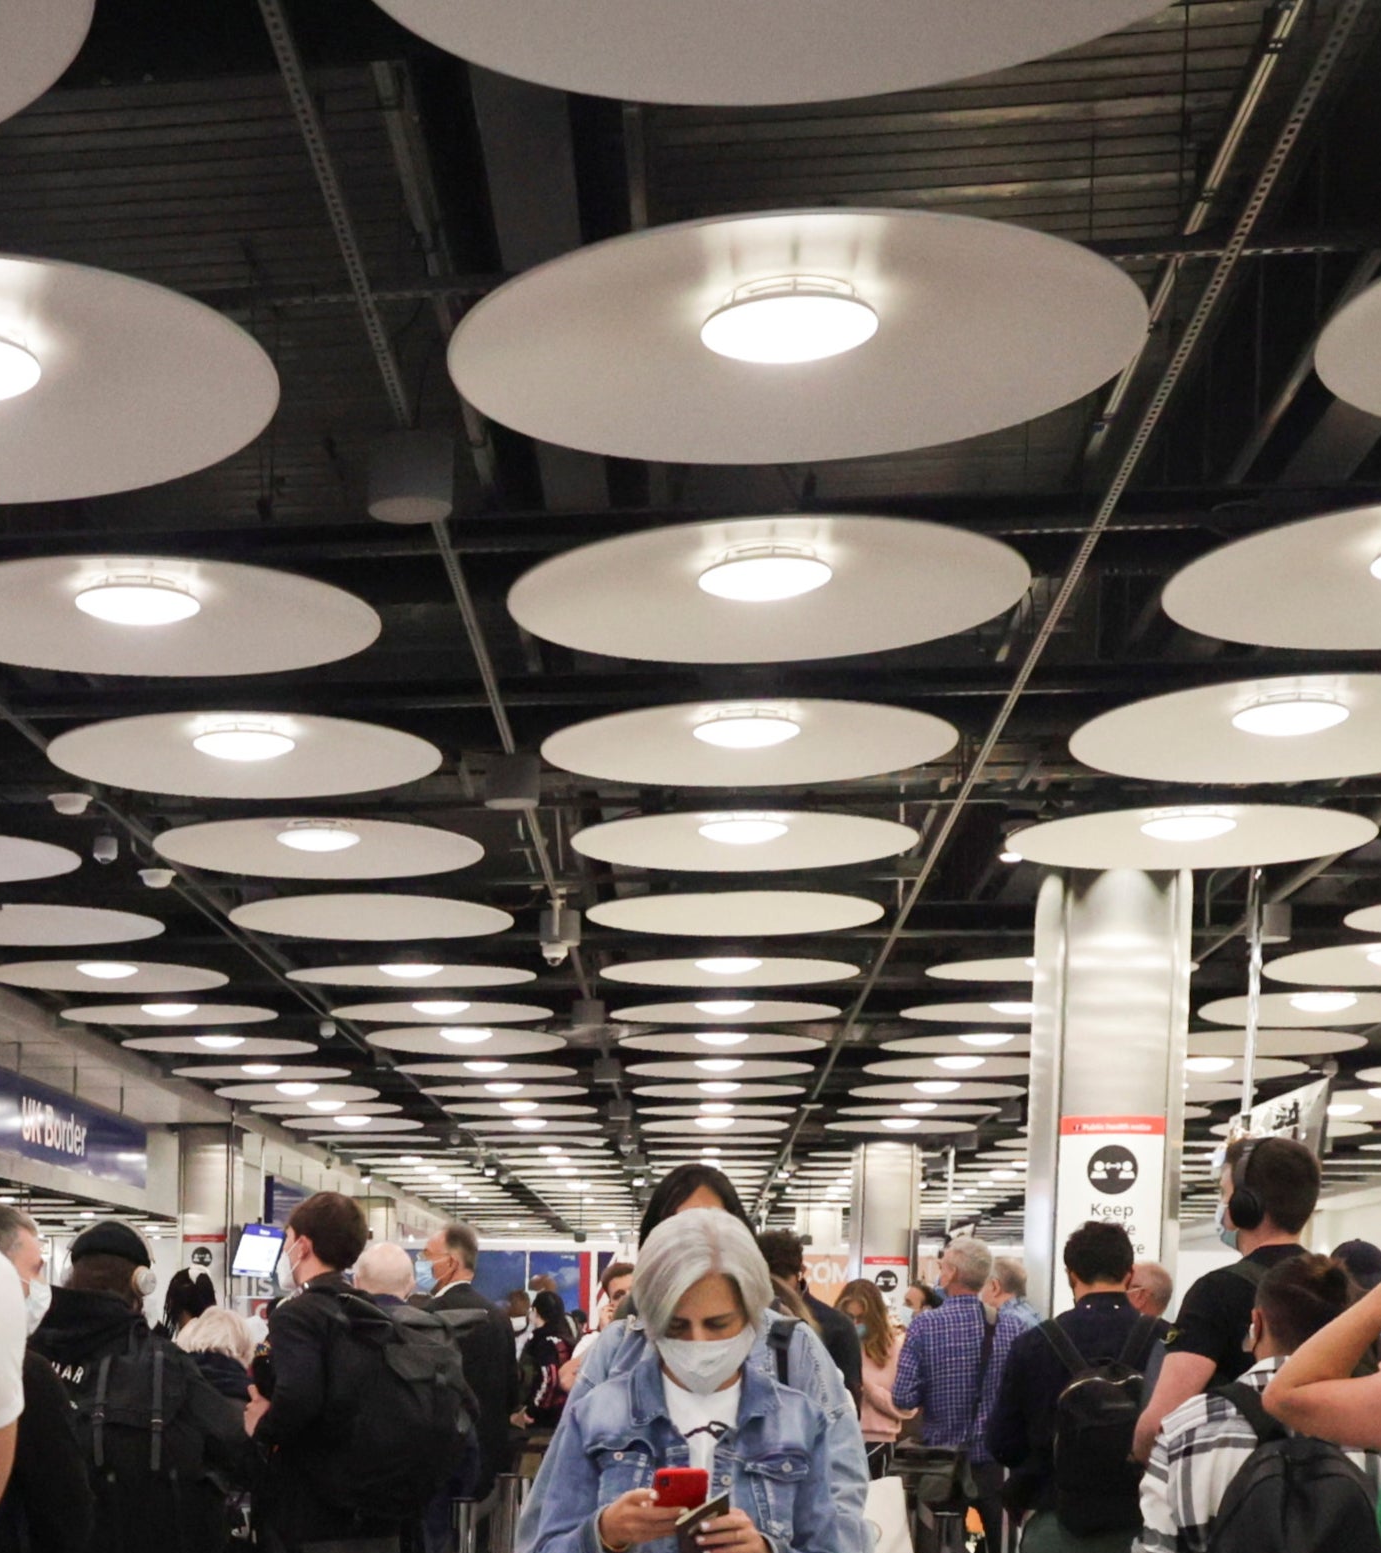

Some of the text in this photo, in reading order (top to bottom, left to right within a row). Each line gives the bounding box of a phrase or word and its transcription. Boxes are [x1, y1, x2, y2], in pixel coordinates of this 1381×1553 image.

[21, 1096, 87, 1157] UK Border
[1090, 1203, 1134, 1220] Keep
